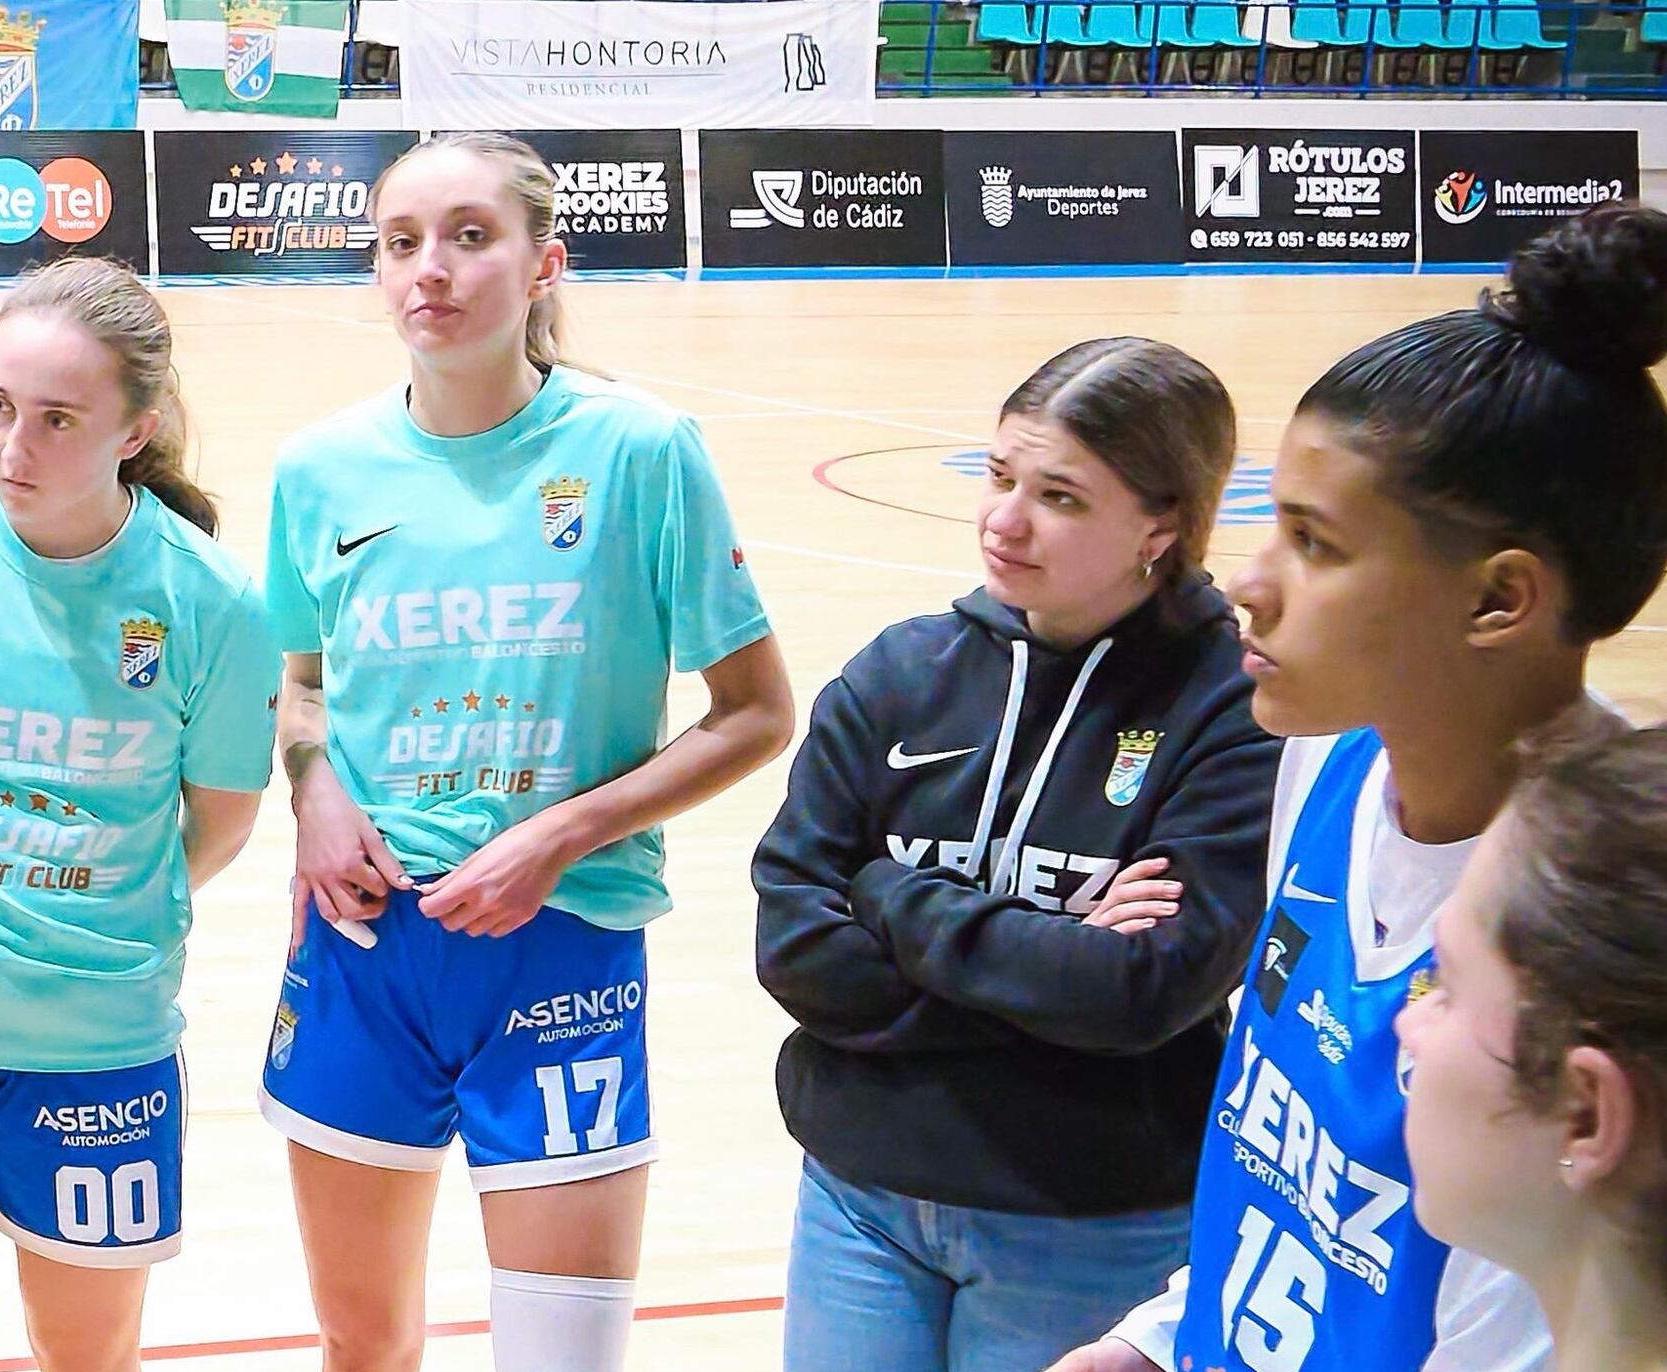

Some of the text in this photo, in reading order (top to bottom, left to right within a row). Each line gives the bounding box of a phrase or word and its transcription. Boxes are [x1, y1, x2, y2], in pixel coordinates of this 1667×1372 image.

[450, 38, 727, 67] VISTAHONTORIA
[526, 81, 652, 97] RESIDENCIAL
[1268, 139, 1406, 174] RÓTULOS
[551, 162, 666, 191] XEREZ
[810, 170, 922, 199] Diputación
[1293, 176, 1381, 203] JEREZ
[45, 180, 104, 218] Tel
[208, 181, 368, 218] DESAFIO
[551, 192, 668, 216] ROOKIES
[1017, 184, 1099, 200] Ayuntamiento
[1100, 185, 1116, 199] de
[1494, 178, 1623, 204] Intermedia2
[812, 203, 904, 229] de Cádiz
[1047, 199, 1119, 219] Deportes
[231, 225, 347, 250] FIT CLUB
[554, 216, 667, 233] ACADEMY
[1209, 230, 1240, 248] 659
[1244, 230, 1273, 248] 723
[1277, 230, 1305, 248] 051
[1317, 231, 1347, 248] 856
[1348, 231, 1379, 248] 542
[1380, 231, 1411, 248] 597
[351, 581, 584, 652] XEREZ
[388, 717, 565, 765] DESAFIO
[416, 767, 535, 798] FIT CLUB
[26, 862, 92, 890] CLUB
[503, 980, 642, 1037] ASENCIO
[537, 1017, 625, 1044] AUTOMOCIÓN
[33, 1089, 168, 1133] ASENCIO
[534, 1055, 623, 1157] 17
[62, 1126, 151, 1147] AUTOMOCIÓN
[55, 1158, 161, 1244] 00
